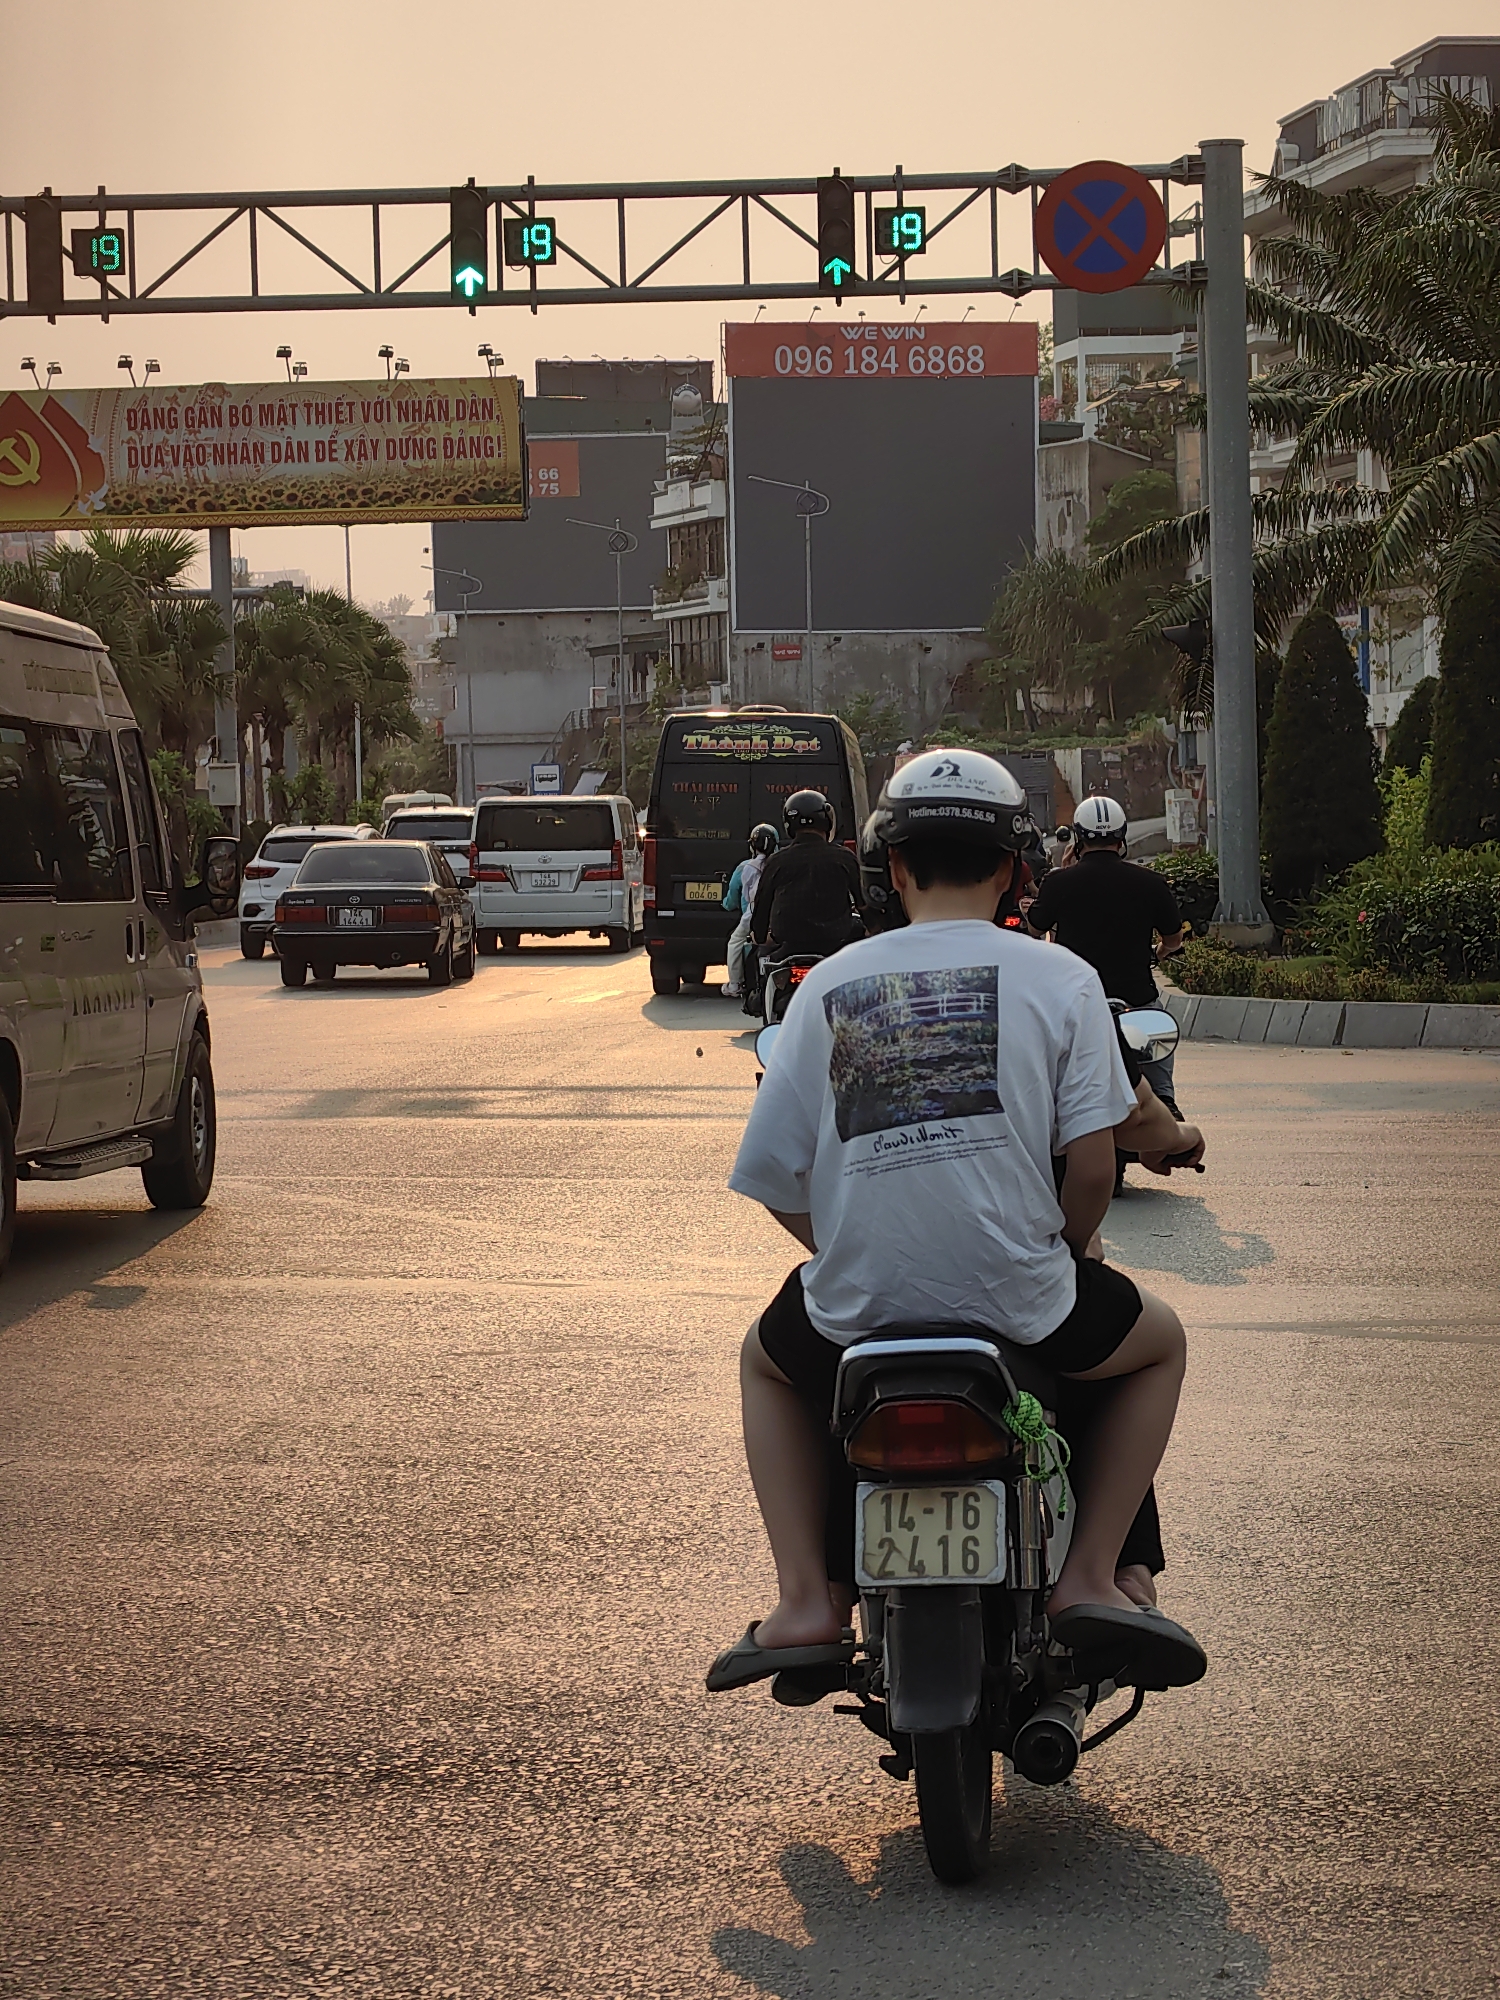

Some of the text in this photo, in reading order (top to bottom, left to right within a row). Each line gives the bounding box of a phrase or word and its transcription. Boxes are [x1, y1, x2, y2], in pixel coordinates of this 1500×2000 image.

[523, 224, 551, 260] 19
[892, 213, 921, 250] 19
[92, 235, 119, 270] 19
[840, 326, 925, 340] WE WIN
[774, 345, 985, 375] 096 184 6868
[126, 393, 502, 432] ĐẢNG GẮN BÓ MẬT THIẾT VỚI NHÂN DÂN,
[127, 428, 503, 475] DỰA VÀO NHÂN DÂN ĐỂ XÂY DỰNG ĐẢNG!
[538, 468, 559, 481] 66
[538, 482, 560, 495] 75
[682, 734, 821, 753] Thành Đạt
[697, 883, 712, 891] 17F
[880, 1491, 981, 1533] 14-T6
